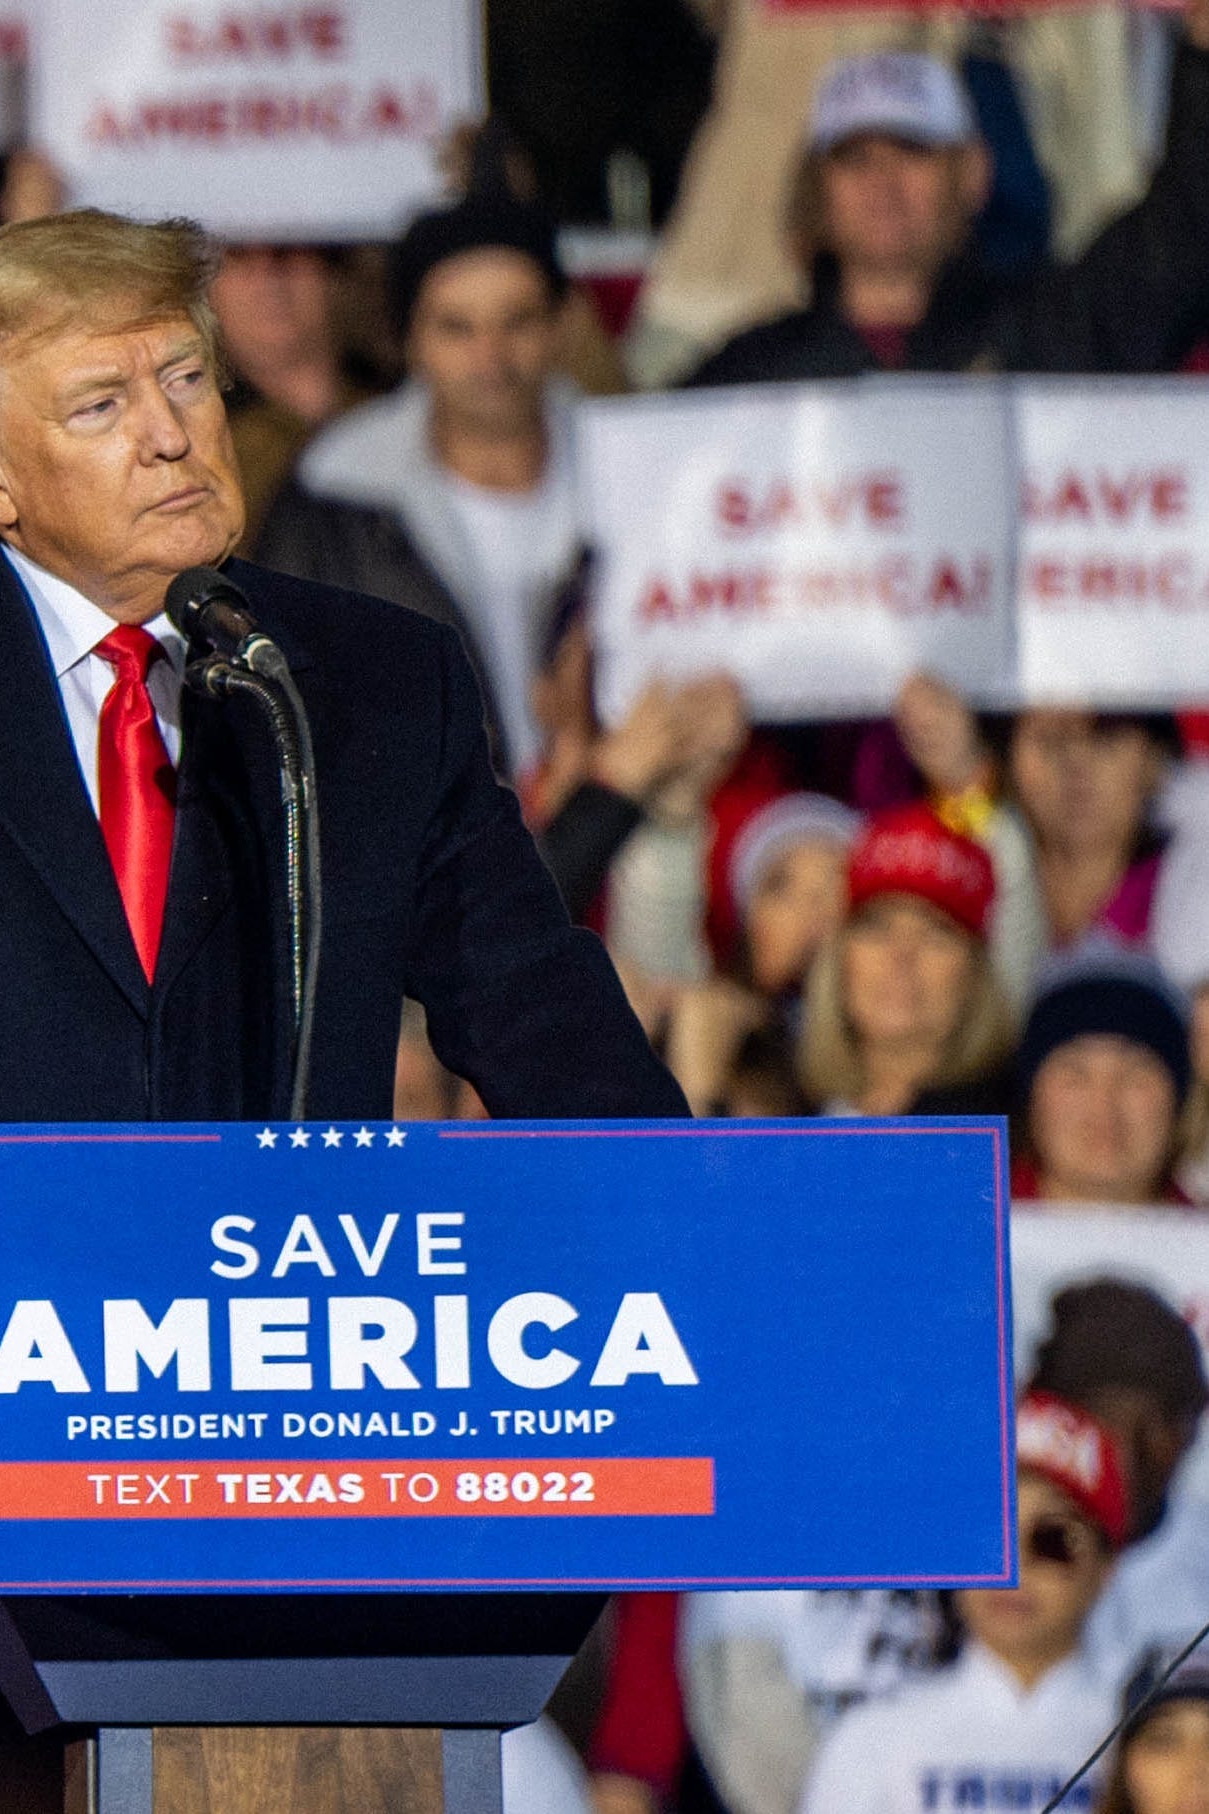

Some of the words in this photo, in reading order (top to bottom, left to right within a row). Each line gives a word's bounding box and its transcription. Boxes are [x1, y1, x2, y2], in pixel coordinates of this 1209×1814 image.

[716, 470, 903, 537] SAVE
[210, 1212, 467, 1280] SAVE
[66, 1413, 268, 1441] PRESIDENT
[282, 1411, 437, 1438] DONALD
[449, 1410, 478, 1437] J.
[490, 1408, 616, 1436] TRUMP
[86, 1473, 200, 1505] TEXT
[215, 1471, 365, 1504] TEXAS
[380, 1471, 440, 1503] TO
[455, 1470, 596, 1503] 88022
